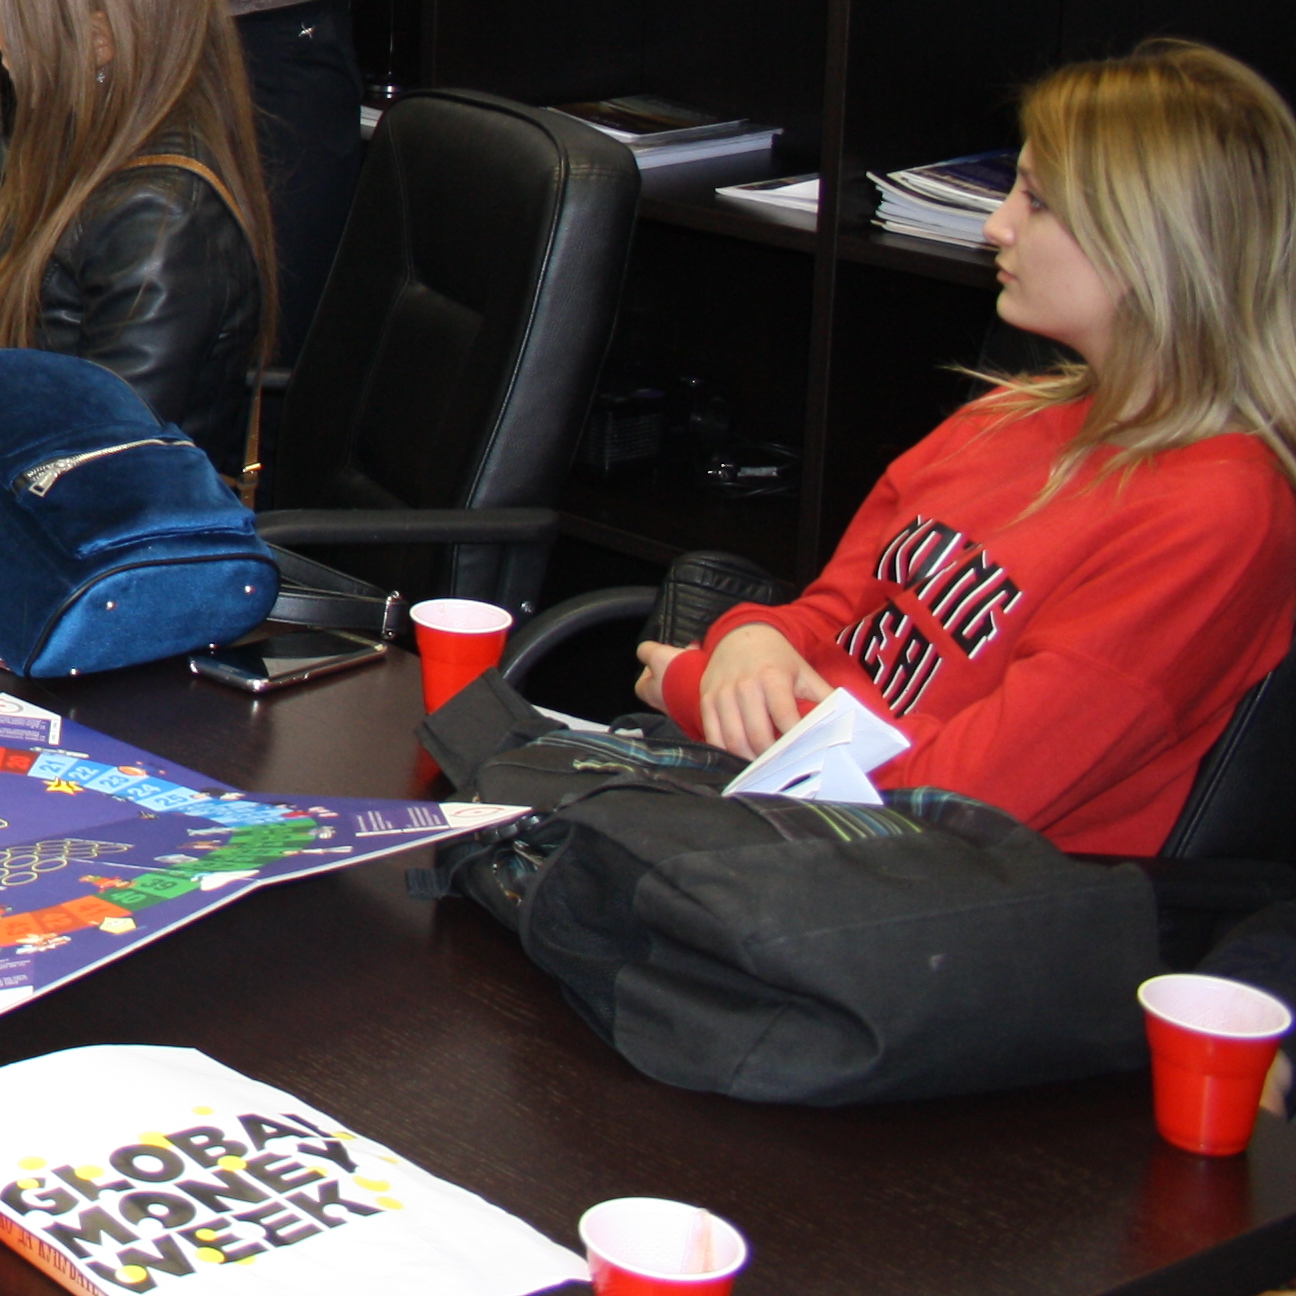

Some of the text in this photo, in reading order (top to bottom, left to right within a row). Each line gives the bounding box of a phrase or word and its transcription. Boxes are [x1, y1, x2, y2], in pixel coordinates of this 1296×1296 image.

[38, 758, 65, 776] 21
[69, 765, 98, 782] 22
[100, 773, 129, 789] 23
[130, 783, 161, 799] 24
[155, 793, 189, 808] 25
[42, 1139, 360, 1260] MONEY
[85, 1180, 386, 1294] WEEK
